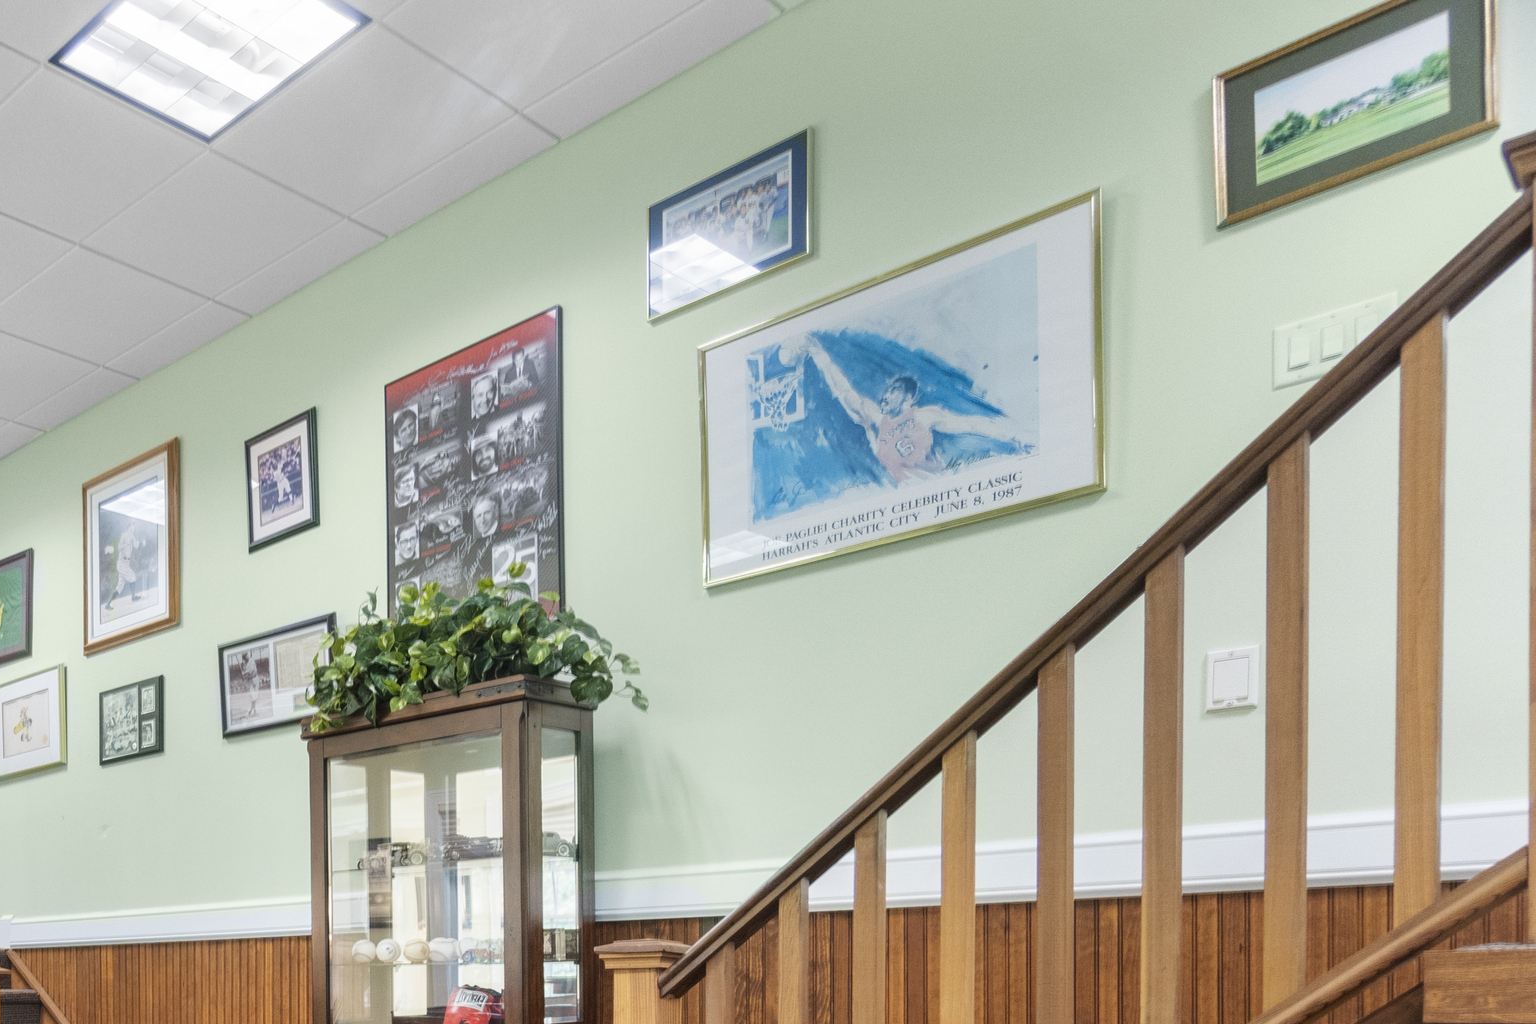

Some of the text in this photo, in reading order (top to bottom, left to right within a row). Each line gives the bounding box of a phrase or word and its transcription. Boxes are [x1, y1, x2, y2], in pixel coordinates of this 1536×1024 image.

[762, 539, 819, 561] HARRAH'S
[824, 522, 885, 545] ATLANTIC
[889, 512, 921, 528] CITY
[934, 499, 968, 518] JUNE
[992, 484, 1023, 502] 1987
[763, 472, 1023, 550] JOE PAGLIEI CHARITY CELEBRITY CLASSIC
[494, 544, 536, 586] 25
